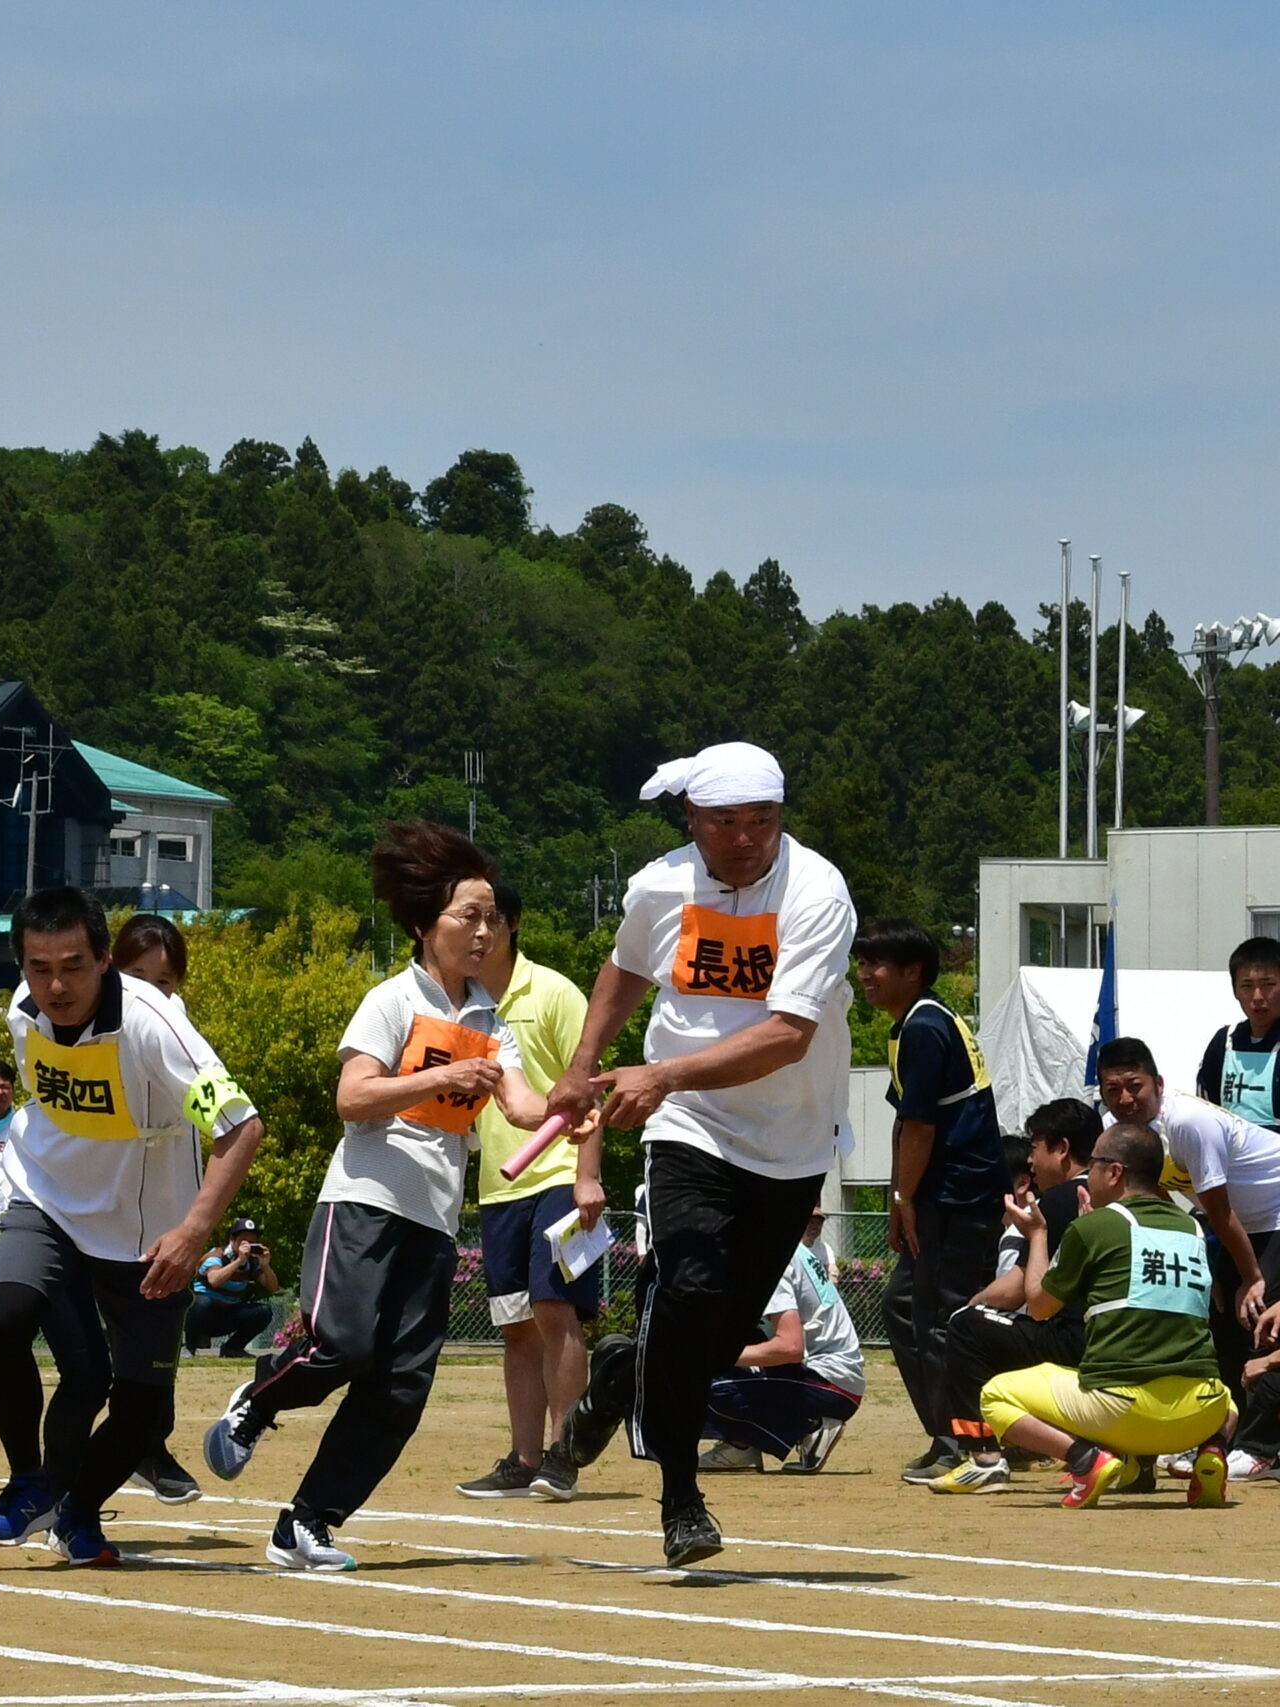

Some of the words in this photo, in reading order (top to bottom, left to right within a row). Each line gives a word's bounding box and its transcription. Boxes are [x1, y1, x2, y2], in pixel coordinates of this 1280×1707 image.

[687, 938, 774, 993] 長根
[35, 1059, 115, 1115] 第四
[1223, 1072, 1266, 1104] 第十一
[1141, 1248, 1206, 1292] 第十三
